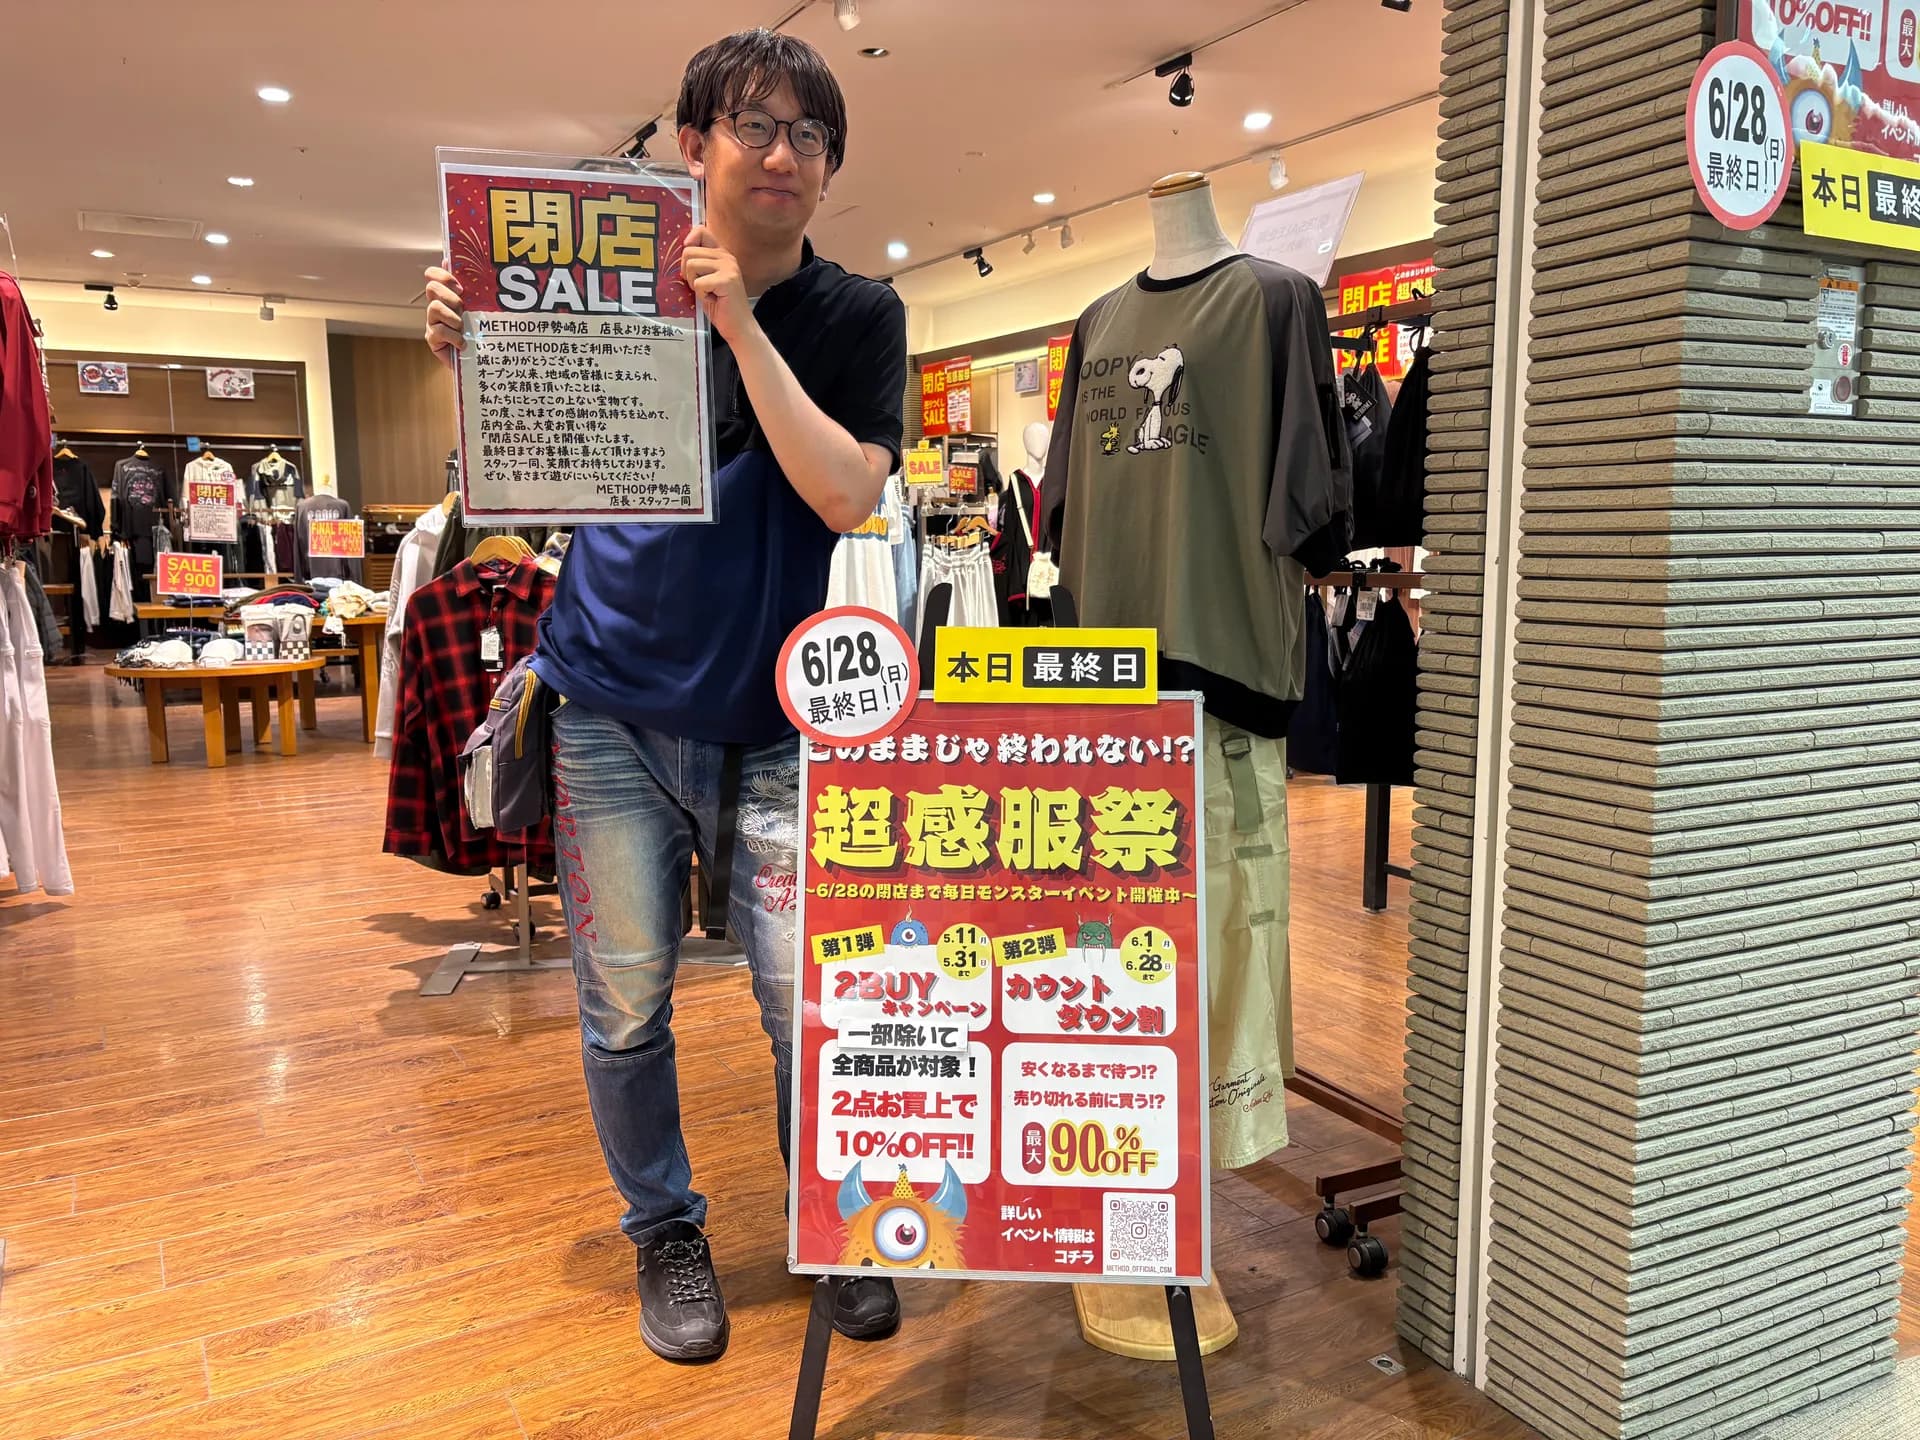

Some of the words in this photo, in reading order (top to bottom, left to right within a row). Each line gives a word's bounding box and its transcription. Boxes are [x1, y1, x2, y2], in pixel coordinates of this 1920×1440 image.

[1901, 17, 1914, 58] 最大
[1811, 168, 1861, 213] 本日
[488, 188, 658, 270] 閉店
[498, 265, 657, 313] SALE
[1343, 281, 1392, 314] 閉店
[479, 320, 589, 335] METHOD伊勢崎店
[600, 321, 684, 337] 店長よりお客様へ
[476, 341, 652, 356] いつもMETHOD店をご利用いただき
[476, 354, 599, 368] 誠にありがとうございます。
[478, 368, 657, 381] オープン以来、地域の皆様に支えられ、
[922, 370, 945, 394] 閉店
[479, 381, 606, 393] 多くの笑顔を頂いたことは、
[1091, 385, 1116, 401] THE
[480, 394, 643, 407] 私たちにとってこの上ない宝物です。
[481, 406, 669, 420] この度、これまでの感謝の気持ちを込めて、
[924, 408, 945, 427] SALE
[1136, 402, 1191, 420] FOUS
[481, 419, 607, 431] 店内全品、大変お買い得な
[481, 432, 635, 445] 「閉店SALE」を開催いたします。
[1135, 424, 1209, 454] AGLE
[483, 445, 666, 457] 最終日までお客様に喜んで頂けますよう
[484, 458, 666, 470] スタッフ一同、笑顔でお待ちしております。
[909, 461, 940, 475] SALE
[952, 469, 973, 479] SALE
[196, 484, 227, 498] 閉店
[596, 484, 691, 495] METHOD伊勢崎店
[198, 497, 227, 505] SALE
[610, 495, 691, 506] 店長・スタッフ一同
[312, 522, 335, 536] FINAL
[338, 522, 362, 536] PRICE
[168, 558, 213, 573] SALE
[947, 651, 1013, 683] 本日
[1033, 651, 1138, 683] 最終日
[807, 683, 906, 727] 最終日!!
[810, 783, 1179, 872] 超感服祭
[944, 927, 976, 944] 5.11
[1131, 931, 1153, 948] 6.1
[821, 932, 875, 958] 第1弾
[1002, 934, 1057, 960] 第2弾
[944, 951, 977, 967] 5.31
[1126, 954, 1163, 972] 6.28
[834, 970, 938, 1001] 2BUY
[1005, 973, 1113, 1003] カウント
[881, 1000, 988, 1018] キャンペーン
[1056, 1003, 1167, 1035] ダウン割
[848, 1022, 959, 1048] 一部除いて
[1021, 1061, 1158, 1080] 安くなるまで待つ!?
[831, 1089, 978, 1119] 2点お買上で
[1013, 1090, 1166, 1110] 売り切れる前に買う!?
[836, 1130, 975, 1160] 10%OFF!!
[1025, 1130, 1042, 1165] 最大
[1001, 1205, 1042, 1220] 詳しい
[1001, 1227, 1095, 1244] イベント情報は
[1054, 1250, 1095, 1265] コチラ
